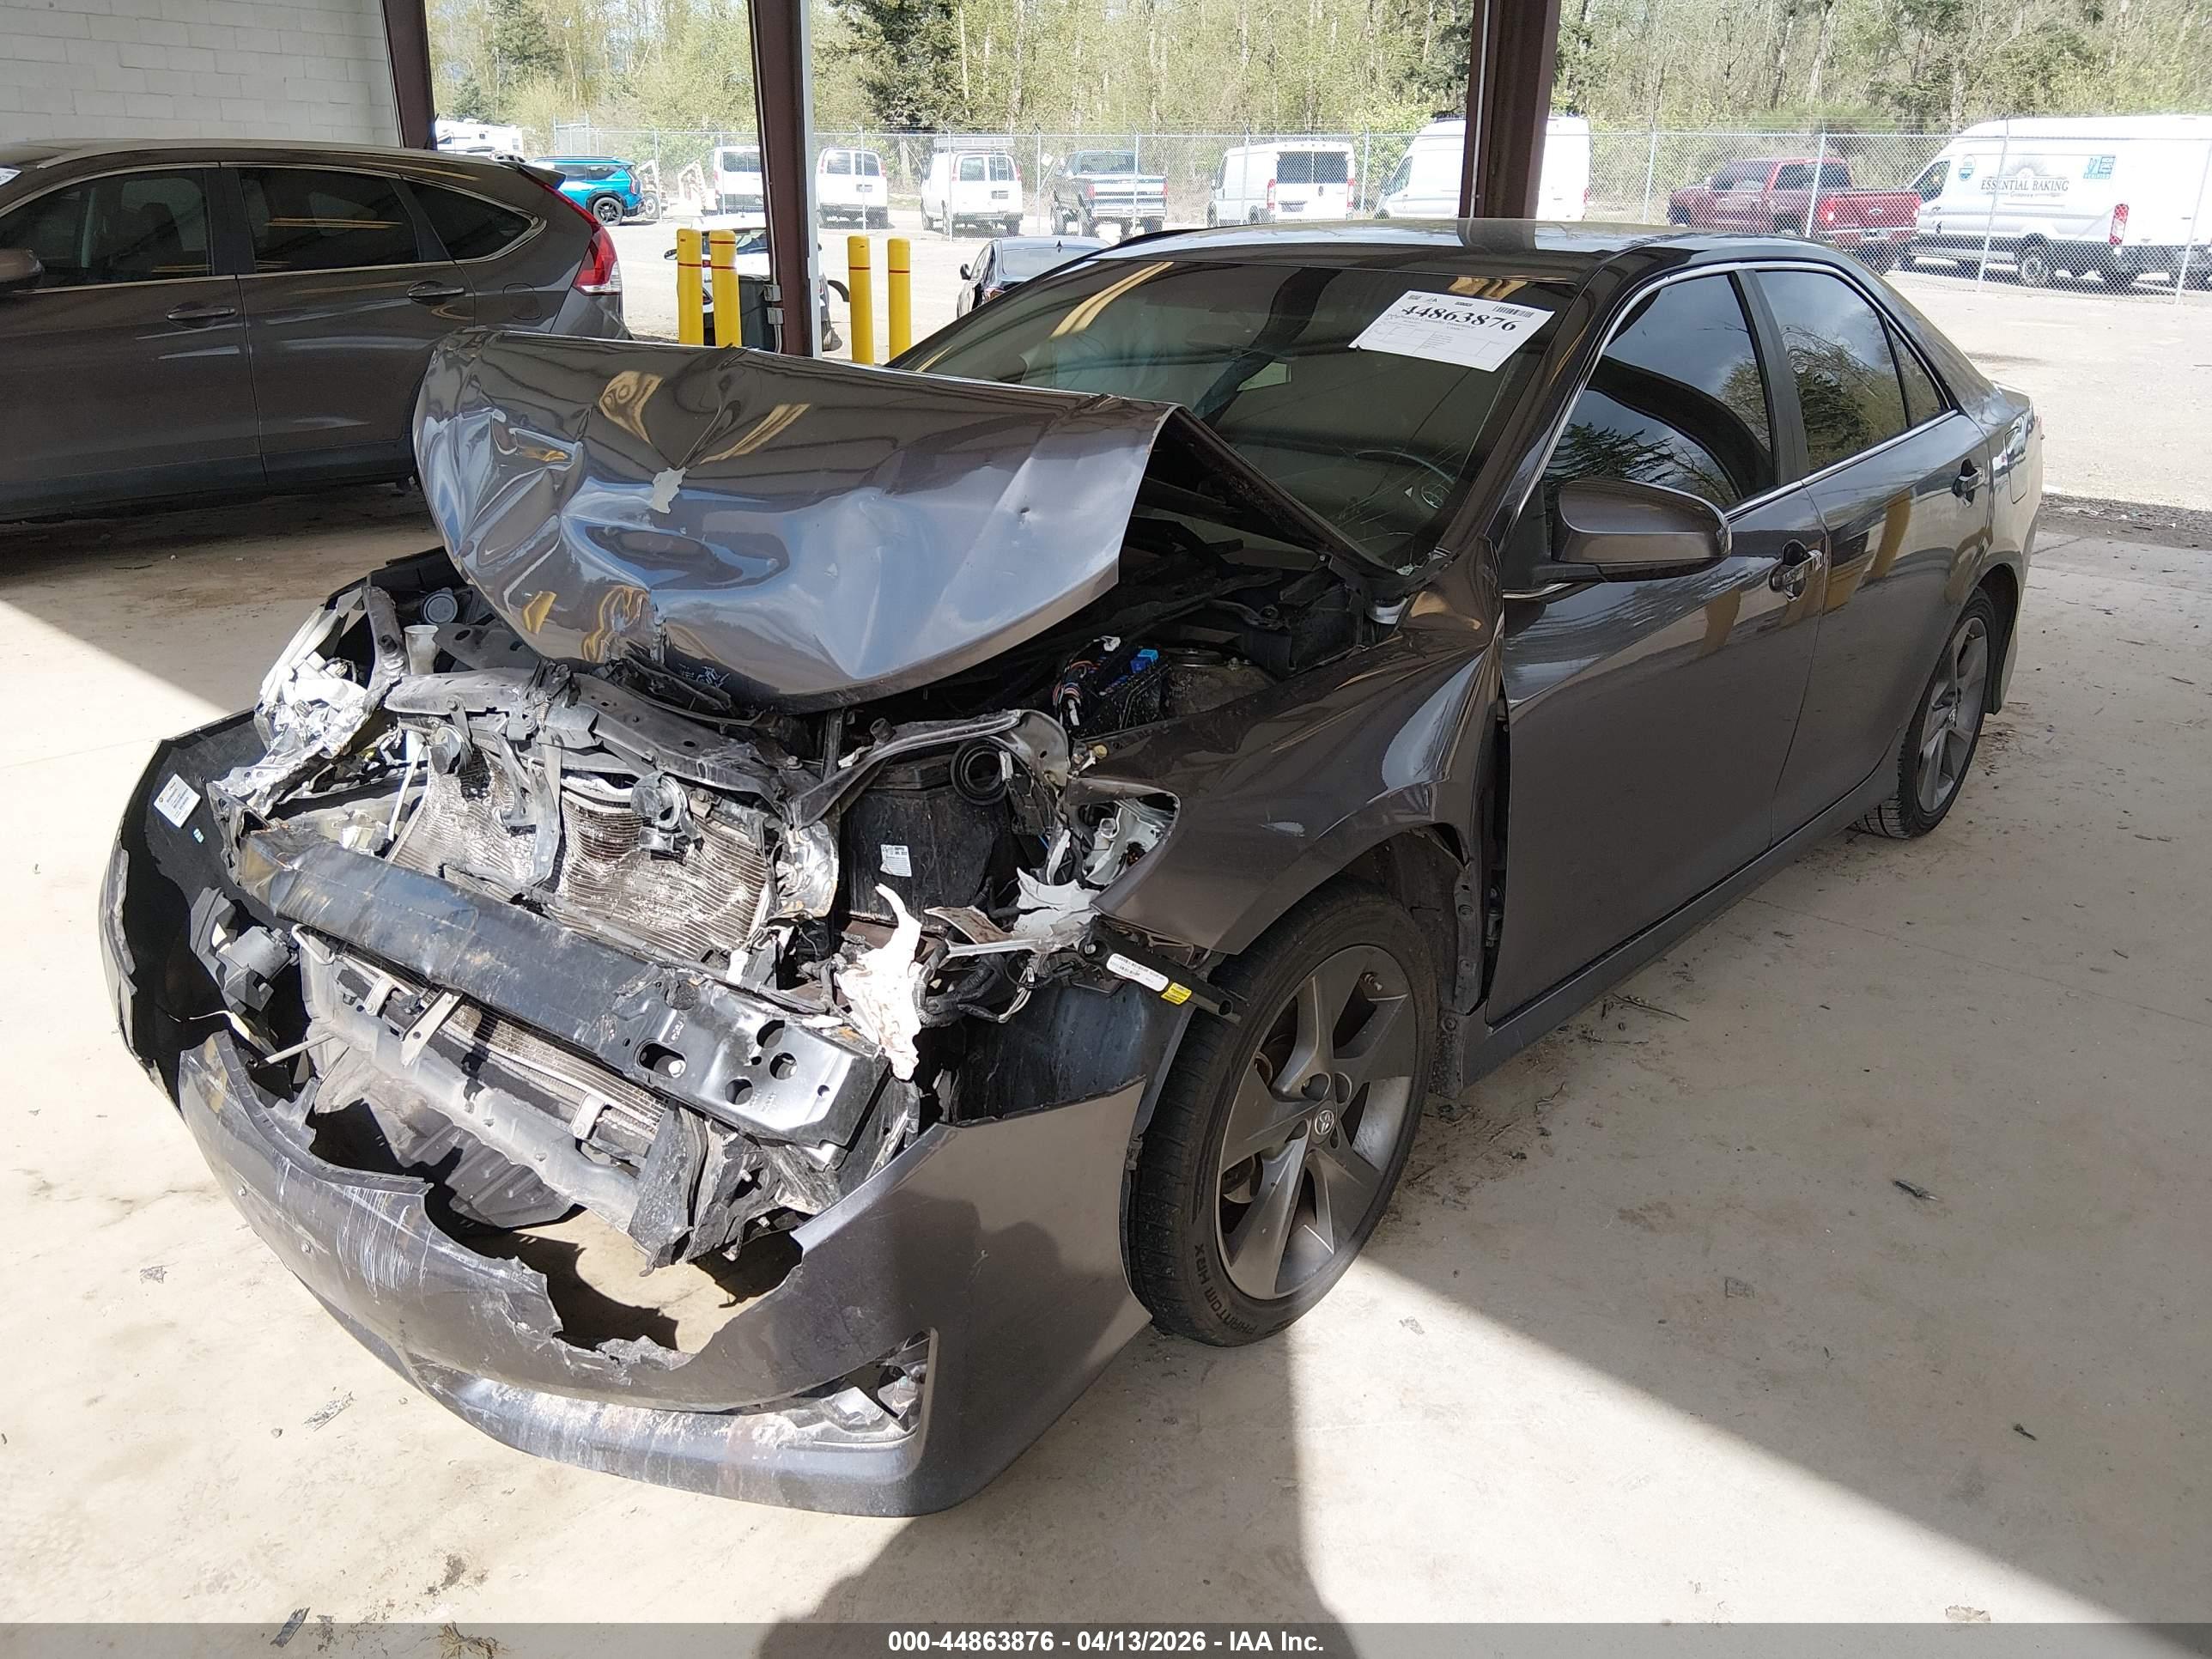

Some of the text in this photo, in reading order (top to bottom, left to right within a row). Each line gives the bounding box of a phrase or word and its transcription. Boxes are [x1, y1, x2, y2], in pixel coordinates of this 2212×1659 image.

[2033, 179, 2069, 191] BAKING
[1401, 305, 1523, 331] 44863876
[1204, 1286, 1259, 1334] PHANTOM
